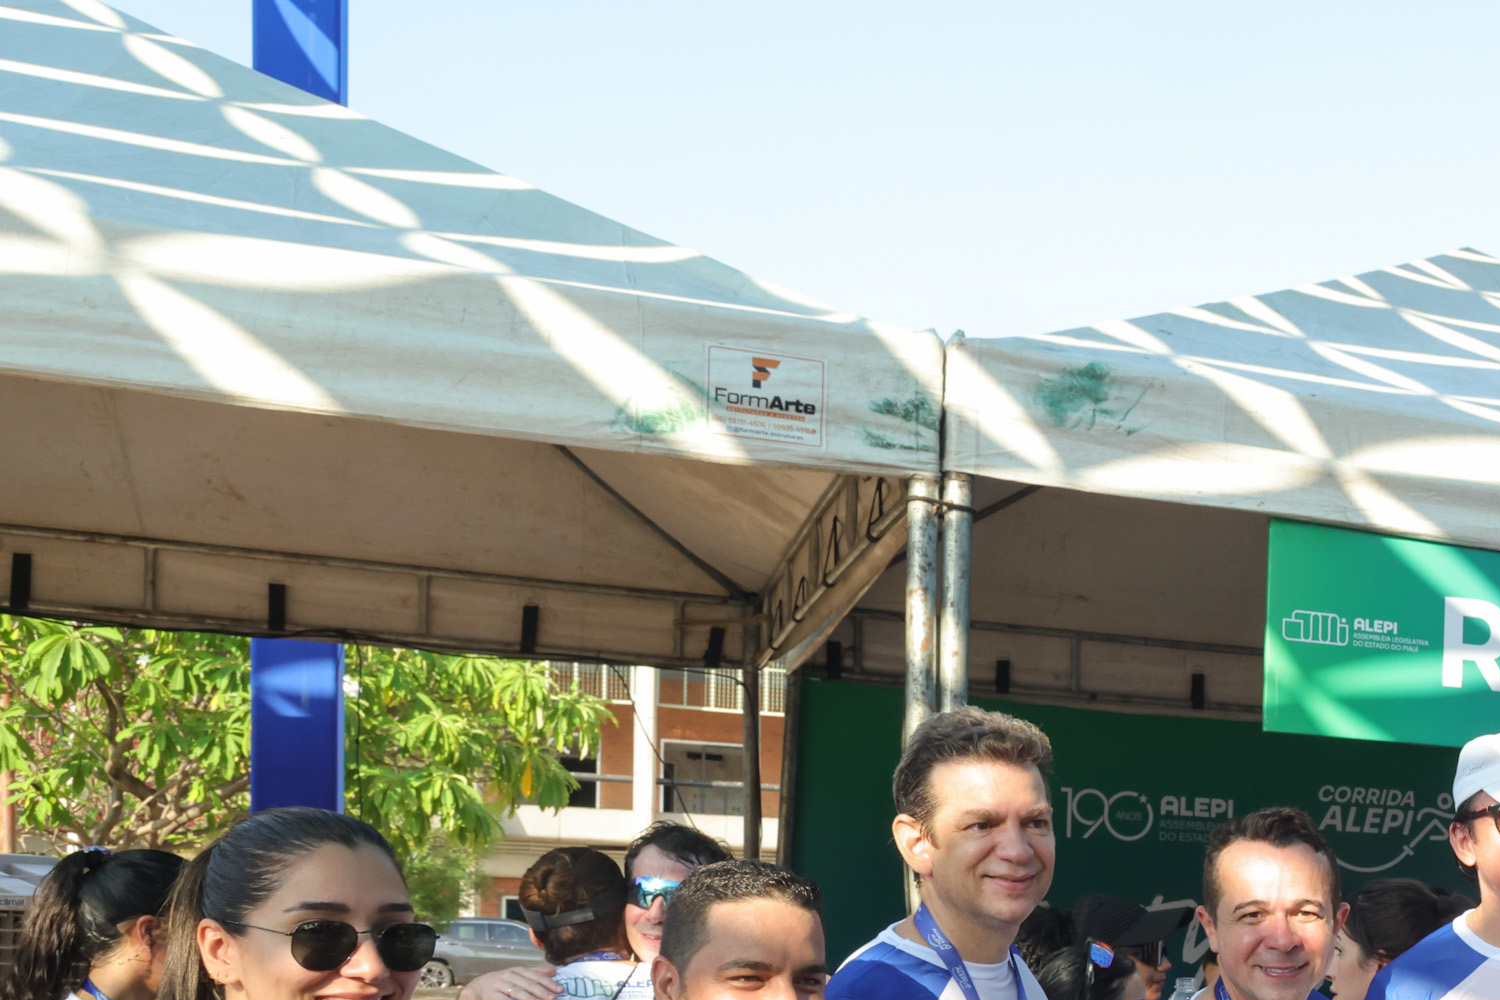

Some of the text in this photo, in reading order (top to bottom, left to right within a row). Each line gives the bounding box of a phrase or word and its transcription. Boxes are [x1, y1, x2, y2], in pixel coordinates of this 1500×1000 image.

[715, 387, 816, 415] FormArte
[1353, 617, 1398, 634] ALEPI
[1353, 633, 1429, 646] ASSEMBLEIA LEGISLATIVA
[1318, 785, 1415, 807] CORRIDA
[1061, 787, 1234, 841] 190 ALEPI
[1318, 805, 1414, 835] ALEPI
[1159, 831, 1176, 841] DO
